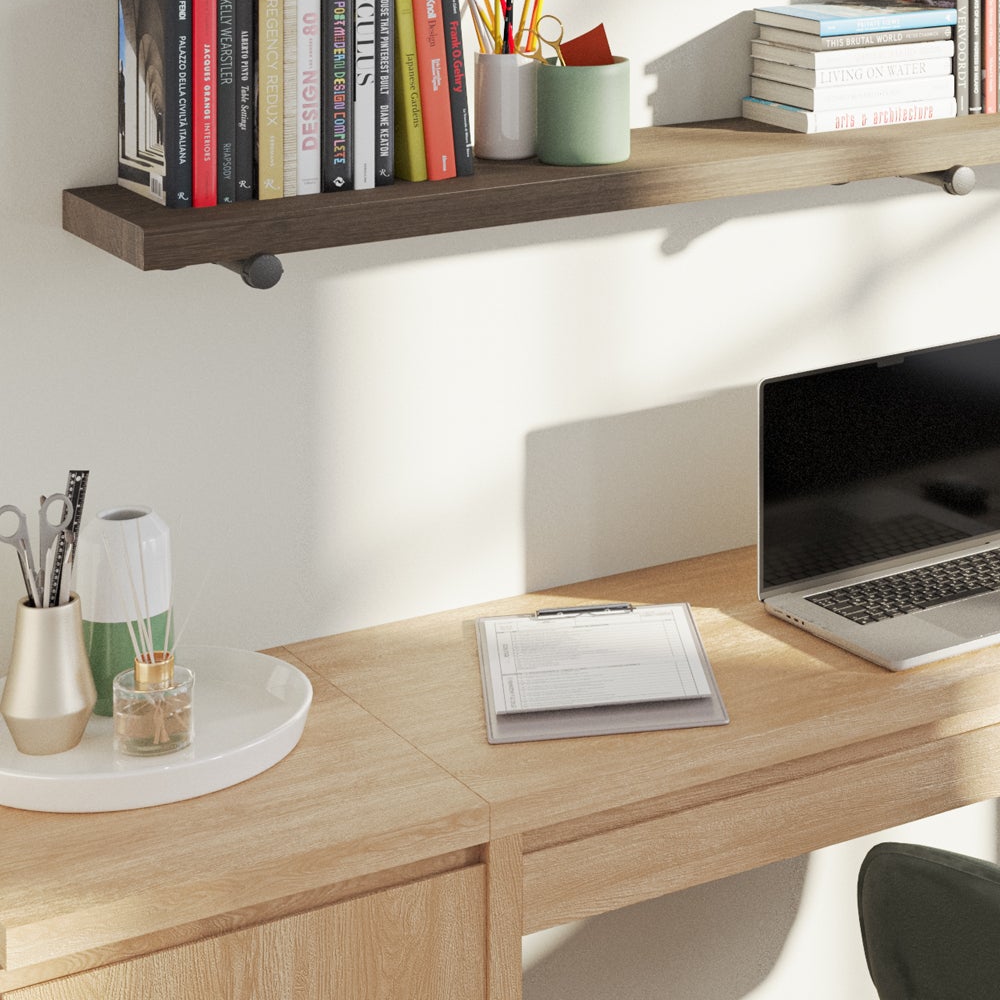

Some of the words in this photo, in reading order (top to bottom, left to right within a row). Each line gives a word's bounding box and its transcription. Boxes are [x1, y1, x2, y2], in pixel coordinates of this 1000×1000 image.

[178, 1, 187, 21] FENDI
[301, 12, 319, 36] 80
[380, 18, 389, 35] THAT
[427, 20, 437, 47] Design
[450, 21, 461, 48] Frank
[826, 39, 844, 48] THIS
[846, 36, 874, 46] BRUTAL
[876, 33, 903, 43] WORLD
[178, 36, 187, 70] PALAZZO
[220, 27, 233, 85] WEARSTLER
[241, 30, 249, 59] ALBERTO
[380, 37, 389, 73] PINTEREST
[452, 49, 461, 61] O.
[958, 6, 967, 89] VERVOORDT
[203, 44, 211, 82] JACQUES
[241, 61, 249, 81] PINTO
[405, 53, 417, 90] Japanese
[452, 61, 463, 93] Gehry
[820, 68, 863, 84] LIVING
[866, 66, 883, 80] ON
[887, 61, 926, 76] WATER
[178, 72, 187, 96] DELLA
[241, 86, 249, 104] Table
[332, 71, 346, 109] DESIGN
[380, 75, 389, 95] BUILT
[178, 98, 188, 127] CIVILTÀ
[203, 85, 211, 120] GRANGE
[266, 75, 279, 127] REDUX
[301, 70, 319, 151] DESIGN
[380, 105, 389, 126] DIANE
[410, 92, 421, 128] Gardens
[238, 105, 249, 131] Settings
[835, 113, 855, 129] arts
[873, 104, 934, 124] architecture
[178, 129, 187, 165] ITALIANA
[203, 123, 211, 161] INTERIORS
[332, 112, 346, 165] COMPLETE
[380, 128, 389, 157] KEATON
[223, 143, 232, 180] RHAPSODY
